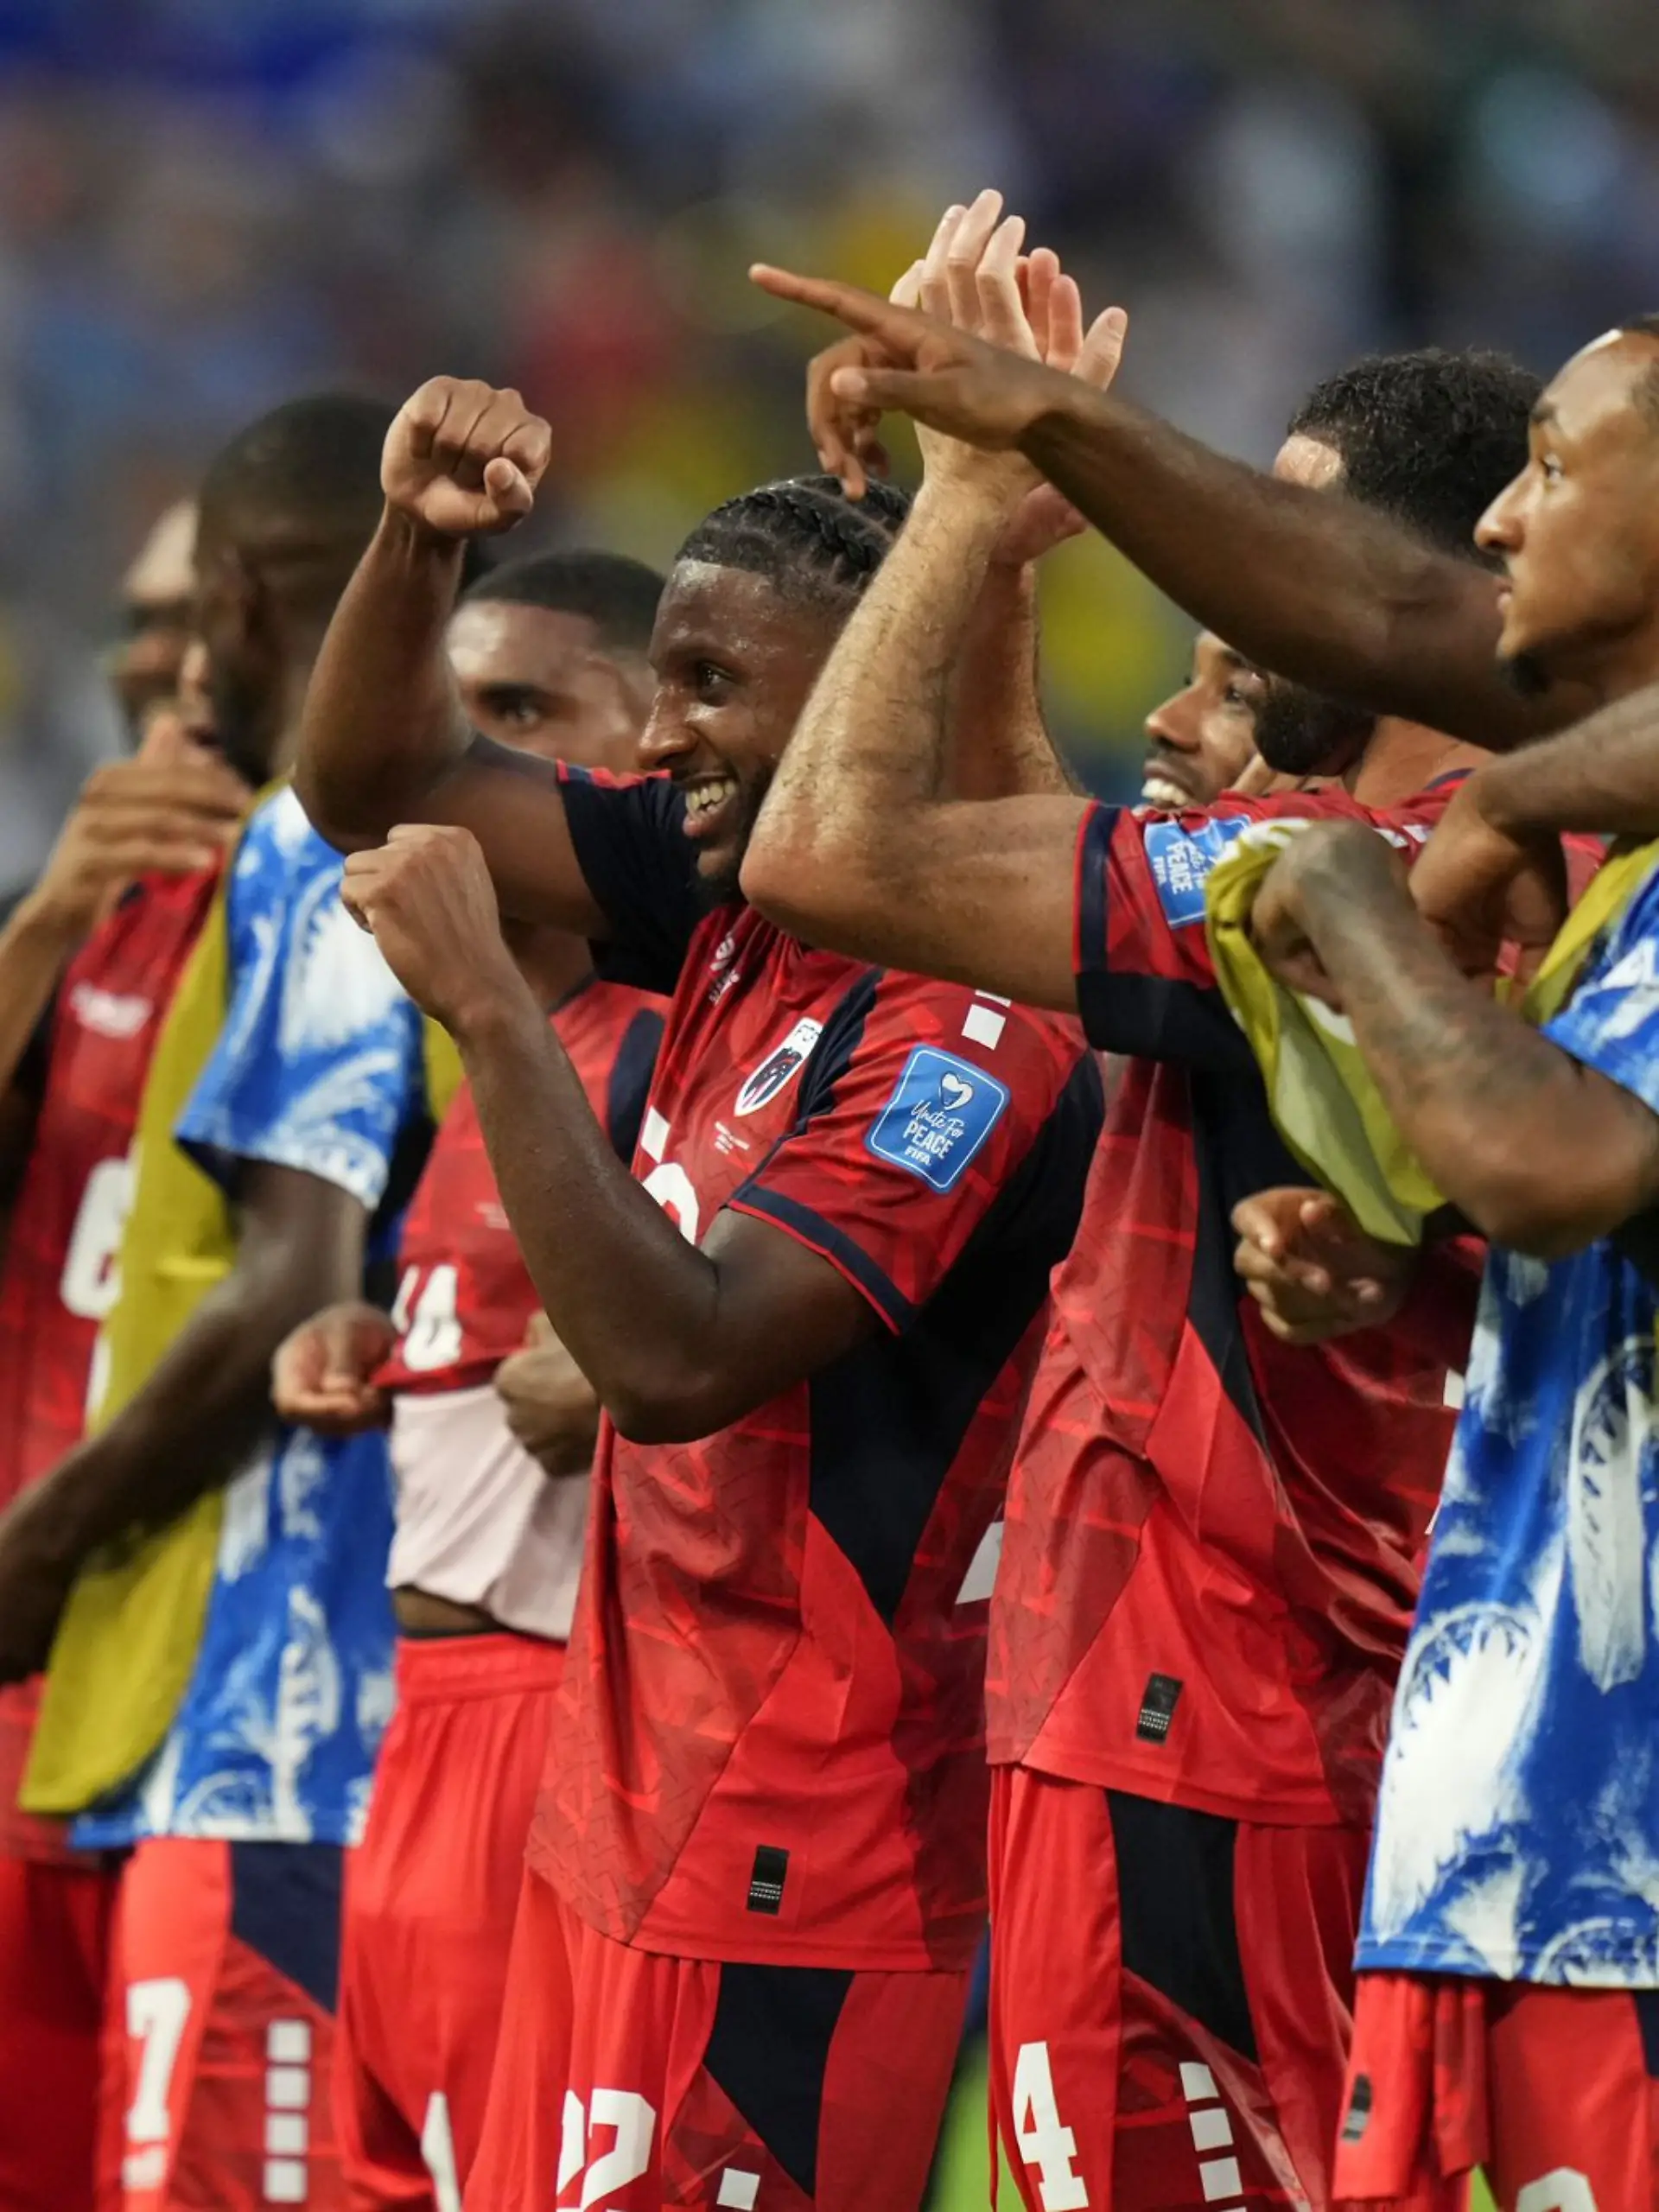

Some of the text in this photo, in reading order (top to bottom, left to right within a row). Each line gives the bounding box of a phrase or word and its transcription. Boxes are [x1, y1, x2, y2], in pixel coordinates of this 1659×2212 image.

[1166, 842, 1193, 895] PEACE
[903, 1122, 954, 1160] PEACE
[911, 1100, 965, 1139] Unite For
[905, 1146, 931, 1166] FIFA
[126, 1977, 192, 2141] 7
[1013, 2041, 1090, 2212] 4
